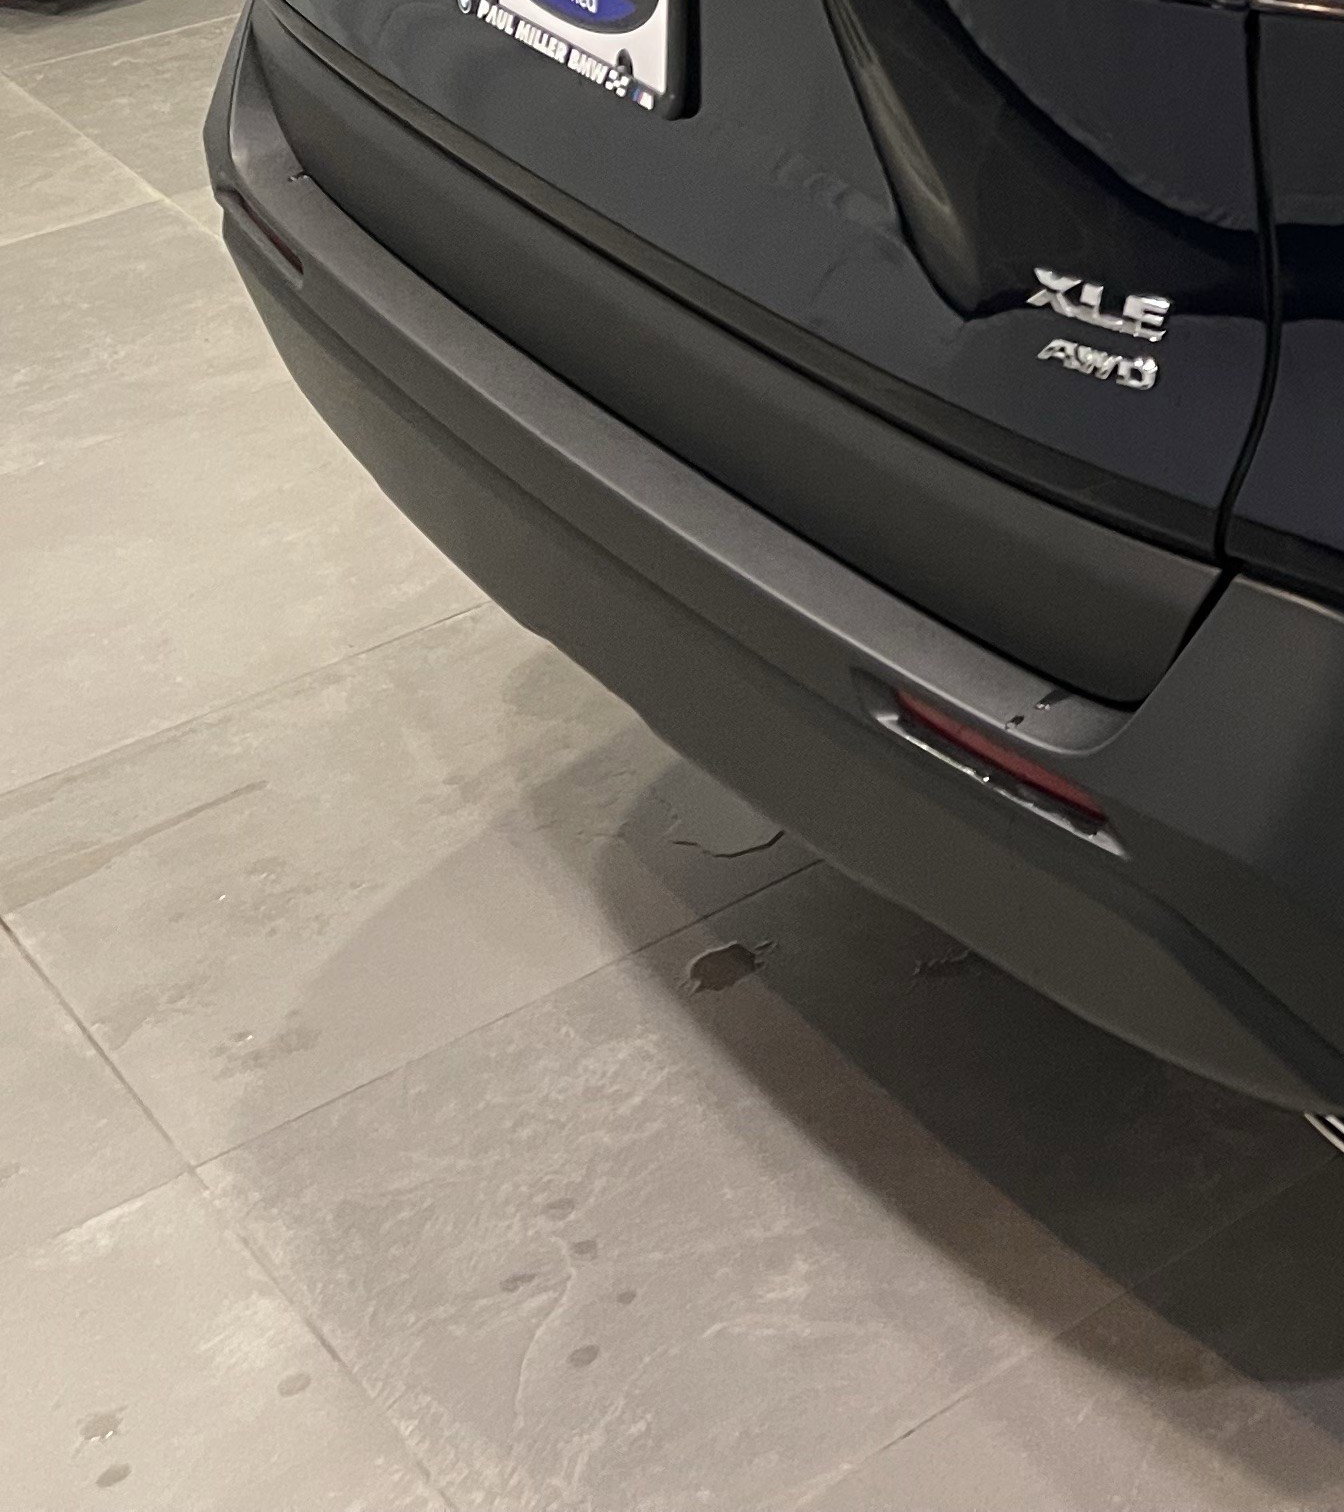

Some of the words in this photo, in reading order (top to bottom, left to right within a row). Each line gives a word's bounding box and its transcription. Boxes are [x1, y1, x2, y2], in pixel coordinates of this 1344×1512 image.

[476, 0, 515, 36] PAUL
[514, 20, 569, 64] MILLER
[567, 48, 609, 85] BMW
[1026, 268, 1170, 342] XLE
[1037, 339, 1158, 390] AWD
